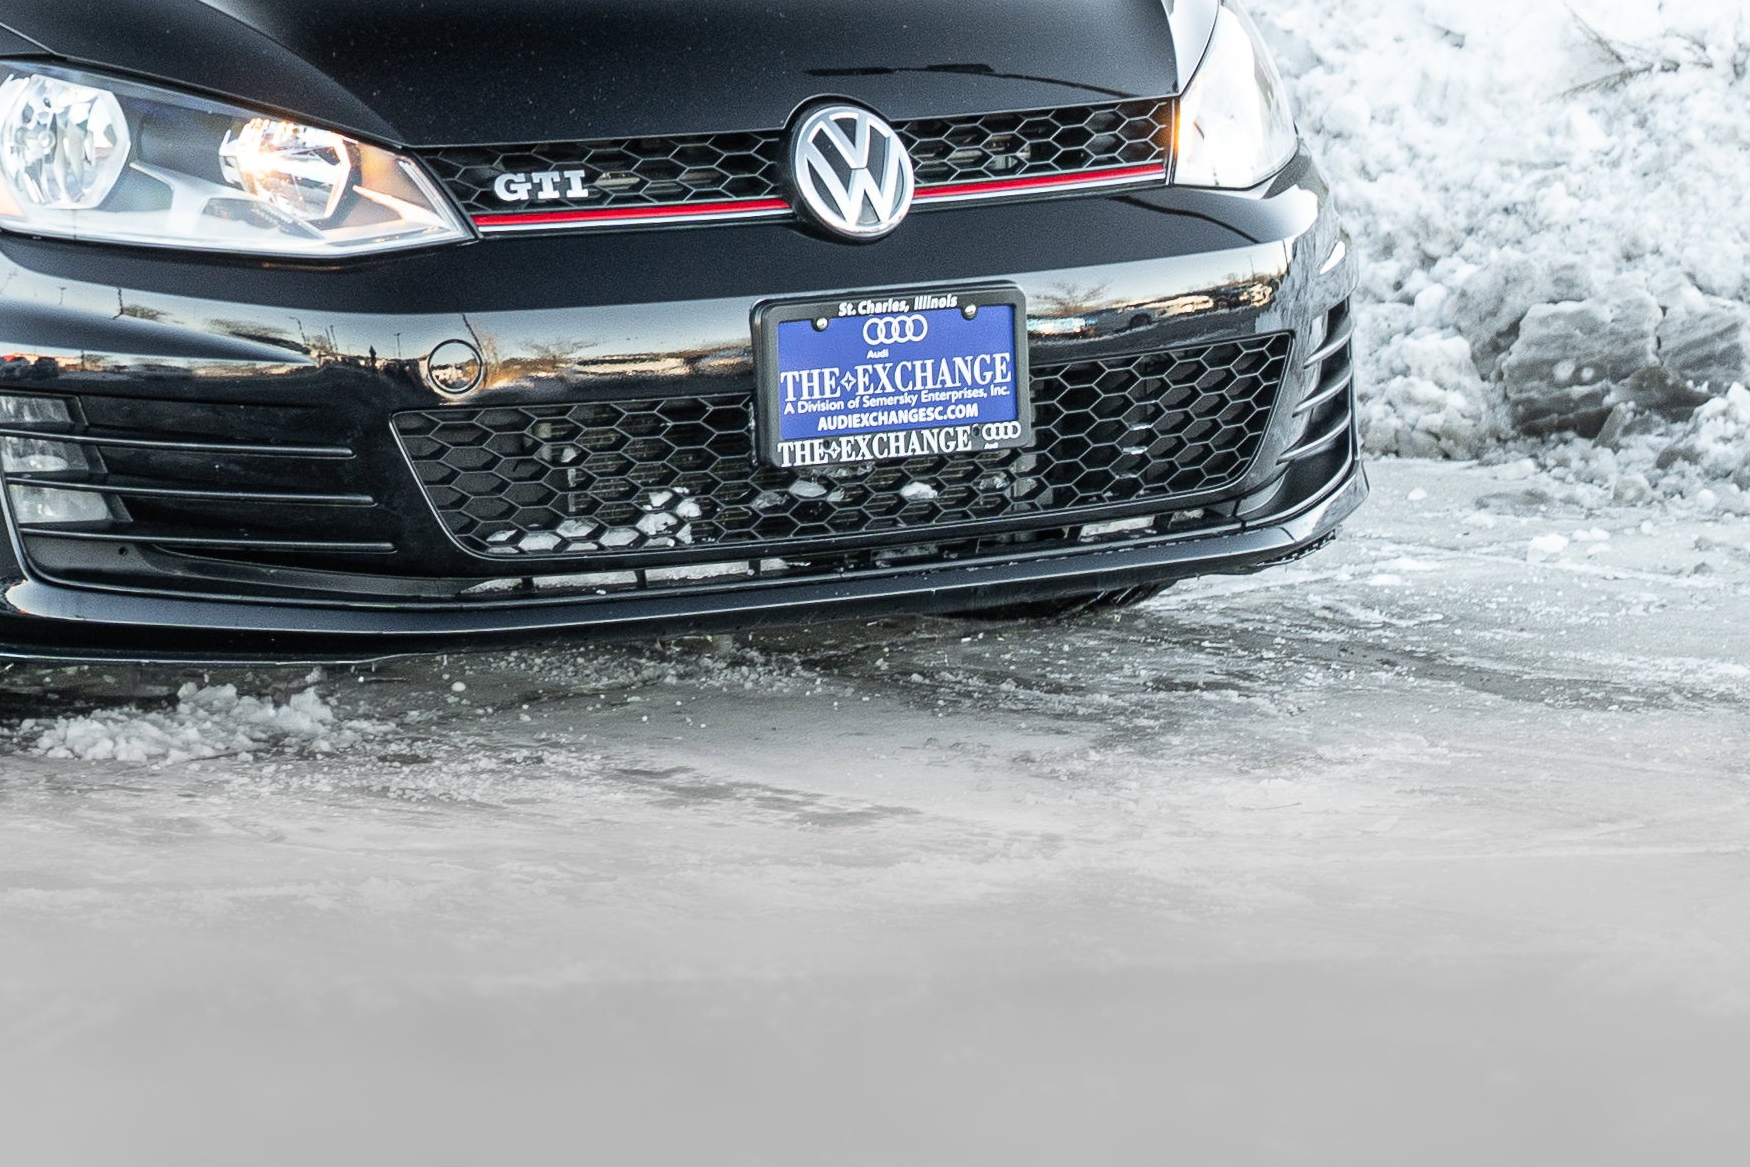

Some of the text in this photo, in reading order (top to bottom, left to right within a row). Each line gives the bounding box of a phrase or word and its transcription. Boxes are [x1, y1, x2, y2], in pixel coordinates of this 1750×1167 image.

[493, 169, 589, 202] GTI
[838, 293, 958, 317] St. Charles, Illinois
[866, 347, 890, 360] Audi
[780, 352, 1012, 402] THE EXCHANGE
[783, 384, 1011, 415] A Division of Semersky Enterprises, Inc.
[817, 402, 979, 431] AUDIEXCHANGESC.COM
[777, 426, 973, 468] THE EXCHANGE
